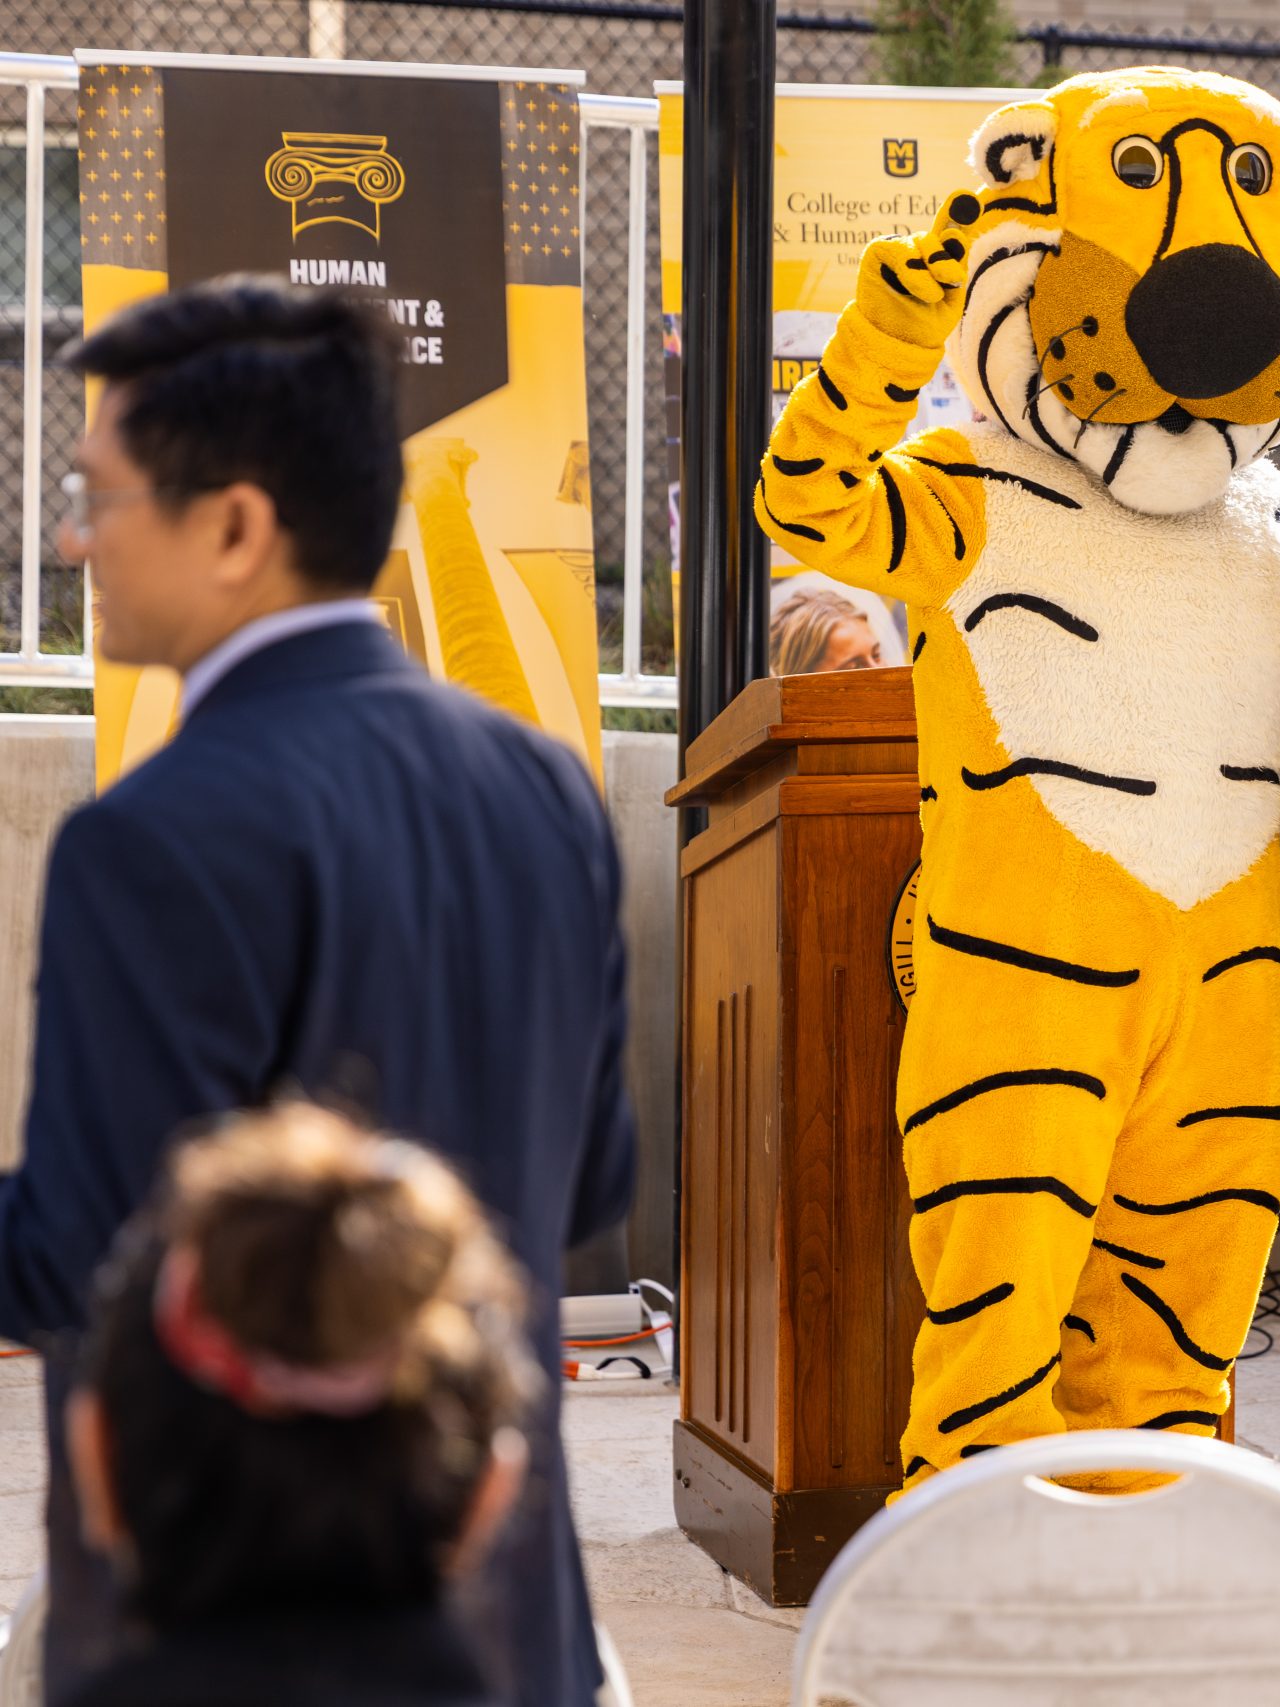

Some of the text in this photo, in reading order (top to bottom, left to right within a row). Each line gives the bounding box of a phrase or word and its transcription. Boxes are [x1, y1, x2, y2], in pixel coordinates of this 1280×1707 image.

[787, 191, 871, 221] College
[878, 194, 902, 214] of
[289, 258, 387, 288] HUMAN
[423, 299, 445, 328] &
